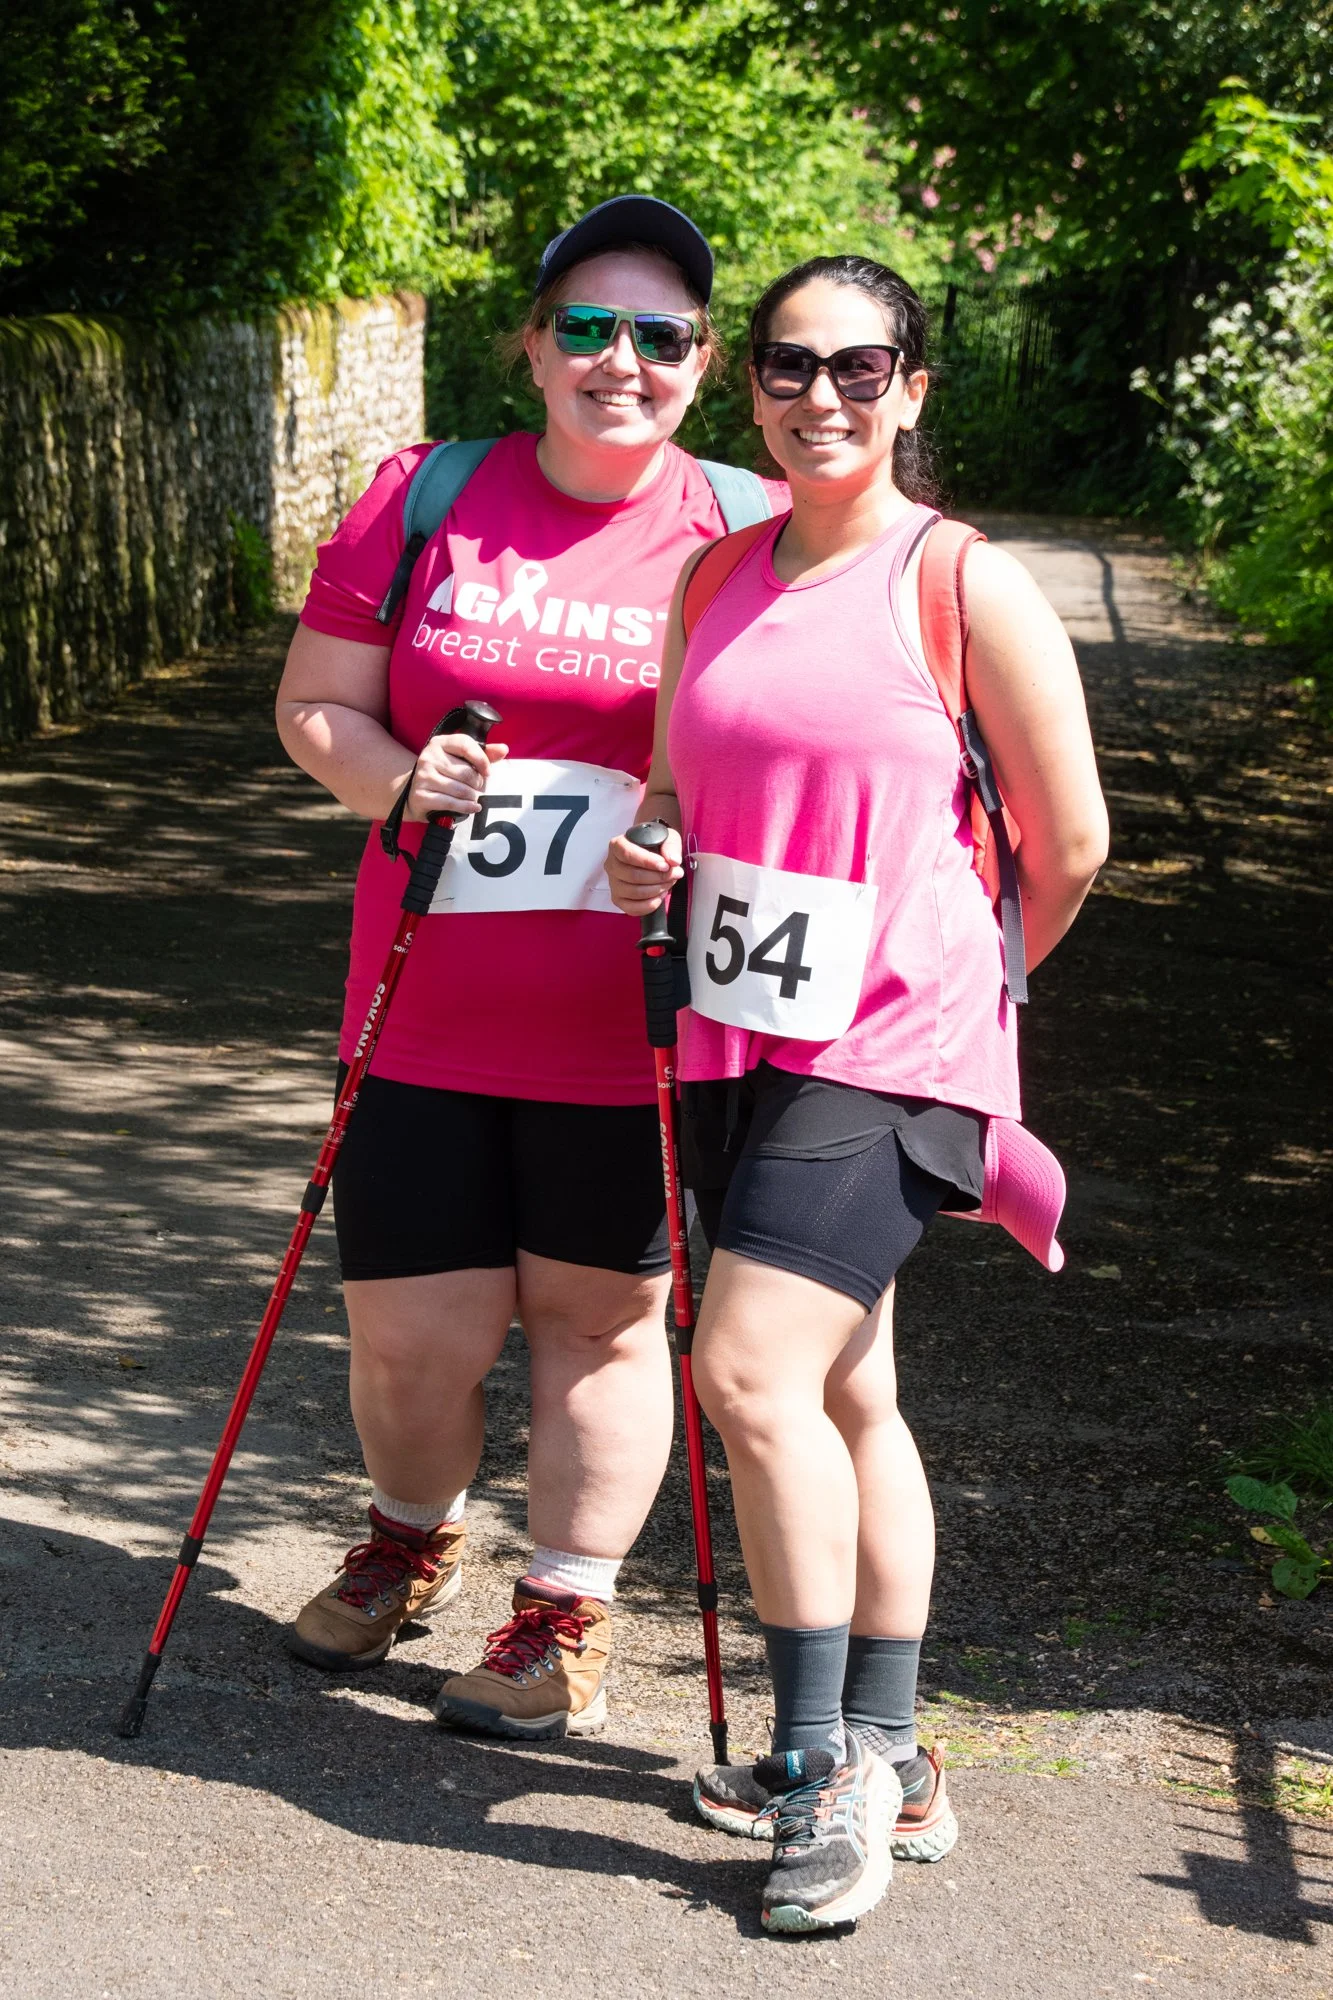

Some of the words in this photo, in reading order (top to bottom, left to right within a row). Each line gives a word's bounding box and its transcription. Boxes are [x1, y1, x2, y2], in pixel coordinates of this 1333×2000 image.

[427, 562, 668, 647] AGAINS
[412, 613, 521, 667] breast
[535, 647, 661, 688] cance
[467, 795, 589, 878] 57
[706, 894, 812, 999] 54
[353, 983, 386, 1058] SOKANA
